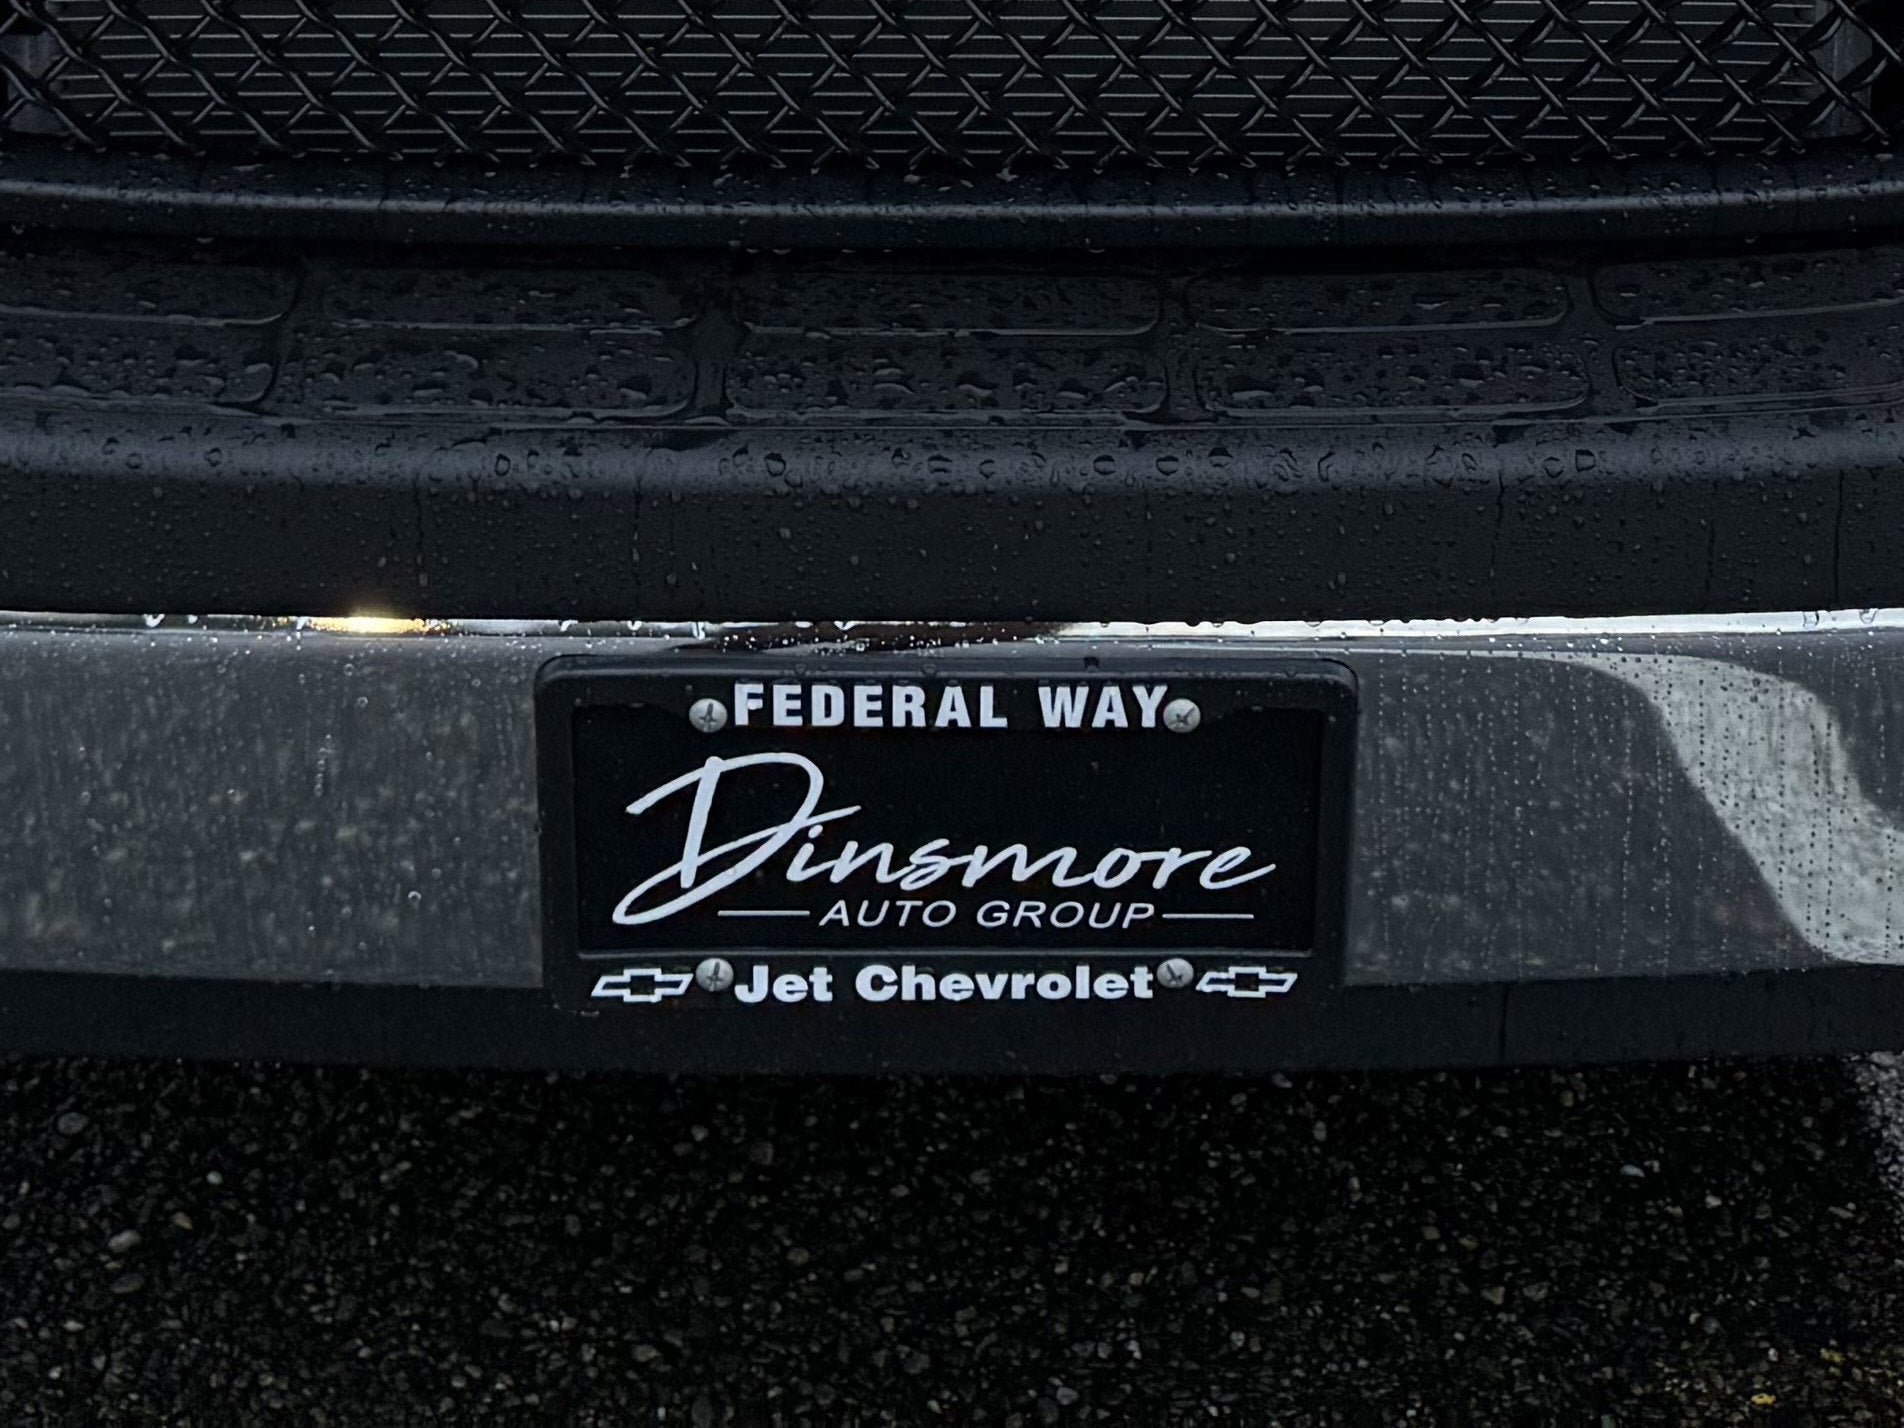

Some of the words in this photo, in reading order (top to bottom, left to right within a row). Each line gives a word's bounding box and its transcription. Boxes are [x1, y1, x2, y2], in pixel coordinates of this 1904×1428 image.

[734, 683, 1008, 728] FEDERAL
[1038, 685, 1168, 728] WAY
[612, 752, 1276, 926] Dinsmore
[818, 899, 957, 927] AUTO
[976, 900, 1155, 929] GROUP
[734, 964, 833, 1003] Jet
[855, 964, 1154, 1002] Chevrolet
